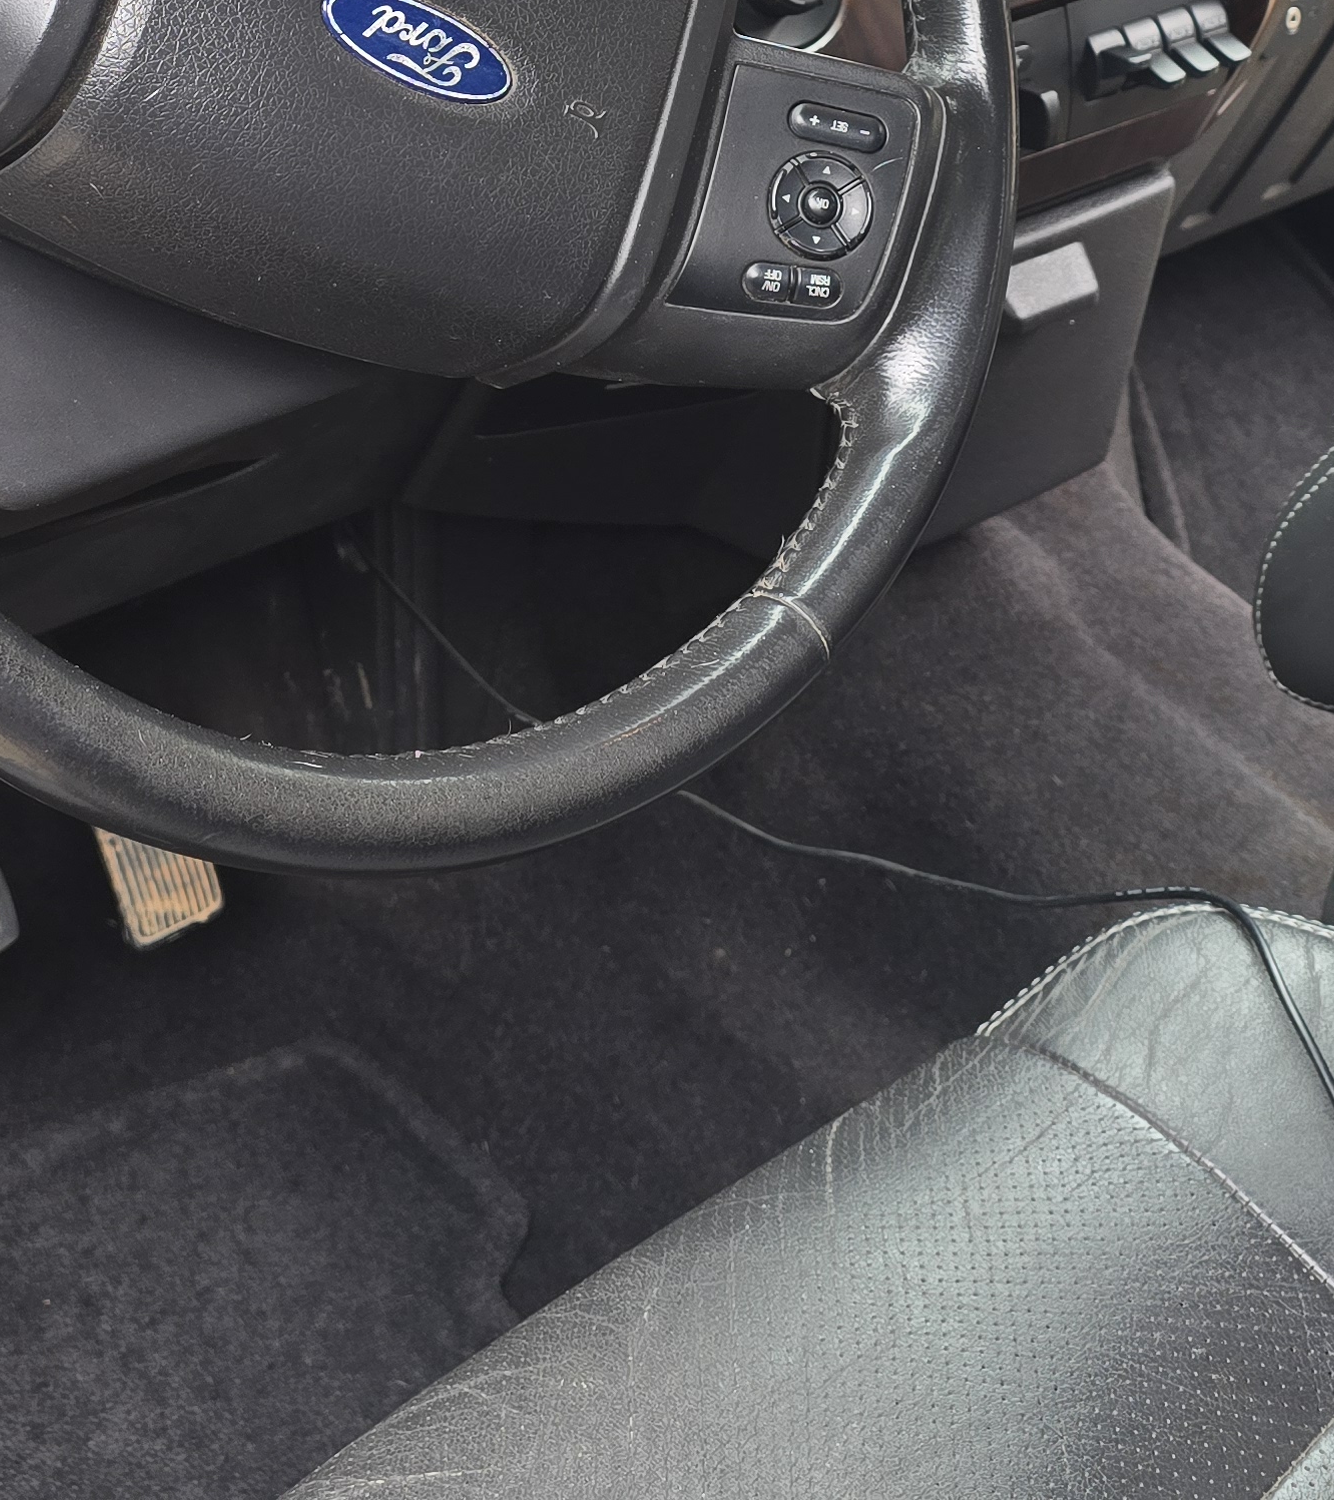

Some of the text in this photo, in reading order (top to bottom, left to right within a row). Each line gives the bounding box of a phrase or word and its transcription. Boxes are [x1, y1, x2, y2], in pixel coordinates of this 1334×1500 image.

[362, 4, 482, 87] Ford
[830, 120, 848, 133] SET
[764, 269, 782, 281] OFF
[810, 274, 831, 286] RSM
